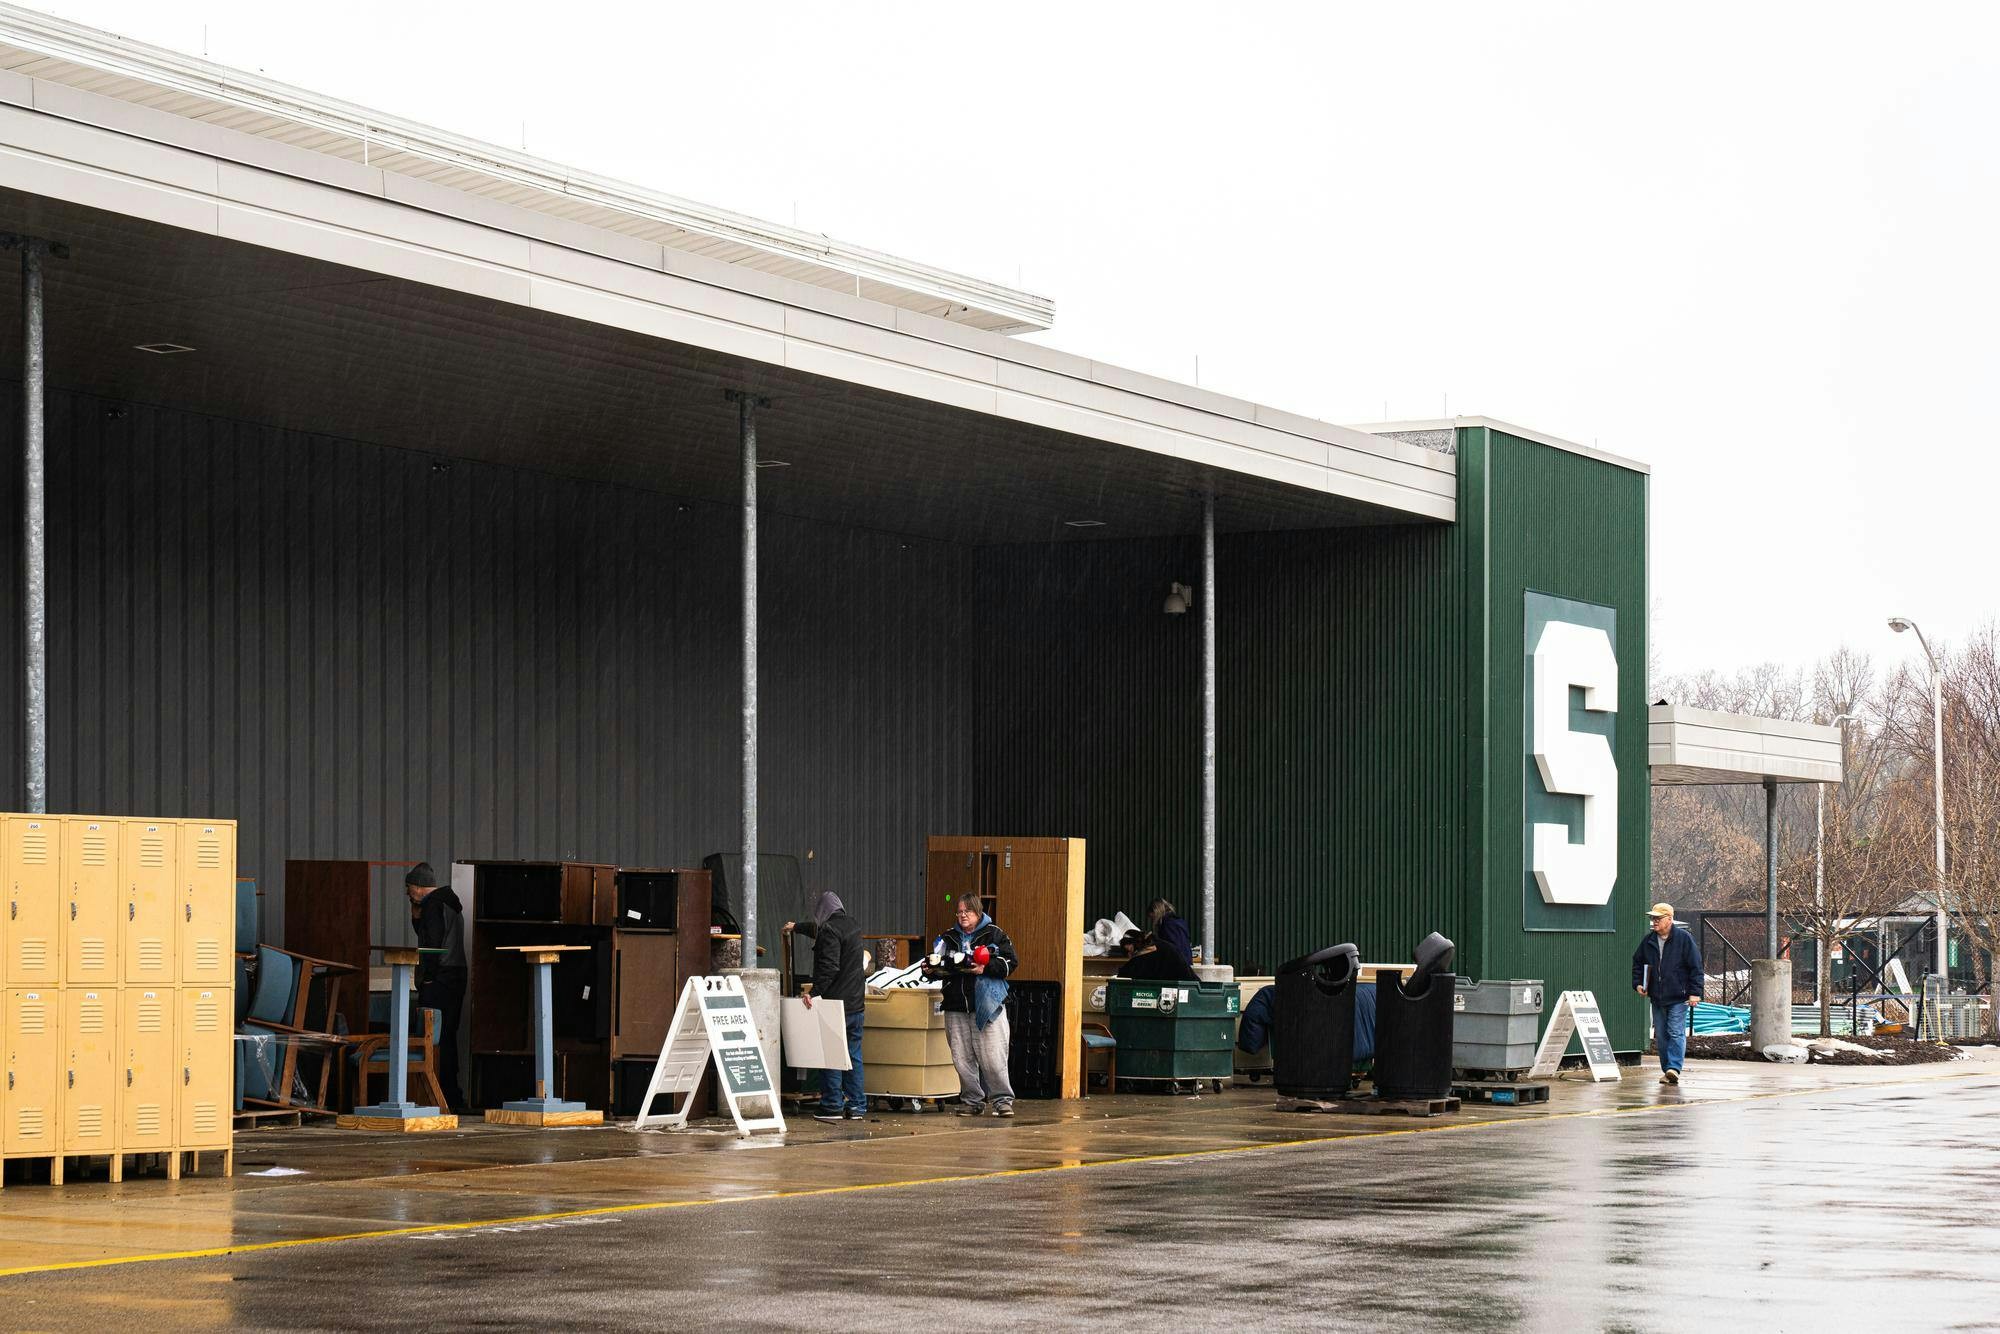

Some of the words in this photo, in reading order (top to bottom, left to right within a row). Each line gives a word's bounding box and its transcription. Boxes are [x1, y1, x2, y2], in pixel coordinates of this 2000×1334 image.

[1533, 621, 1618, 905] S
[712, 1015, 730, 1026] FREE
[730, 1014, 749, 1025] AREA
